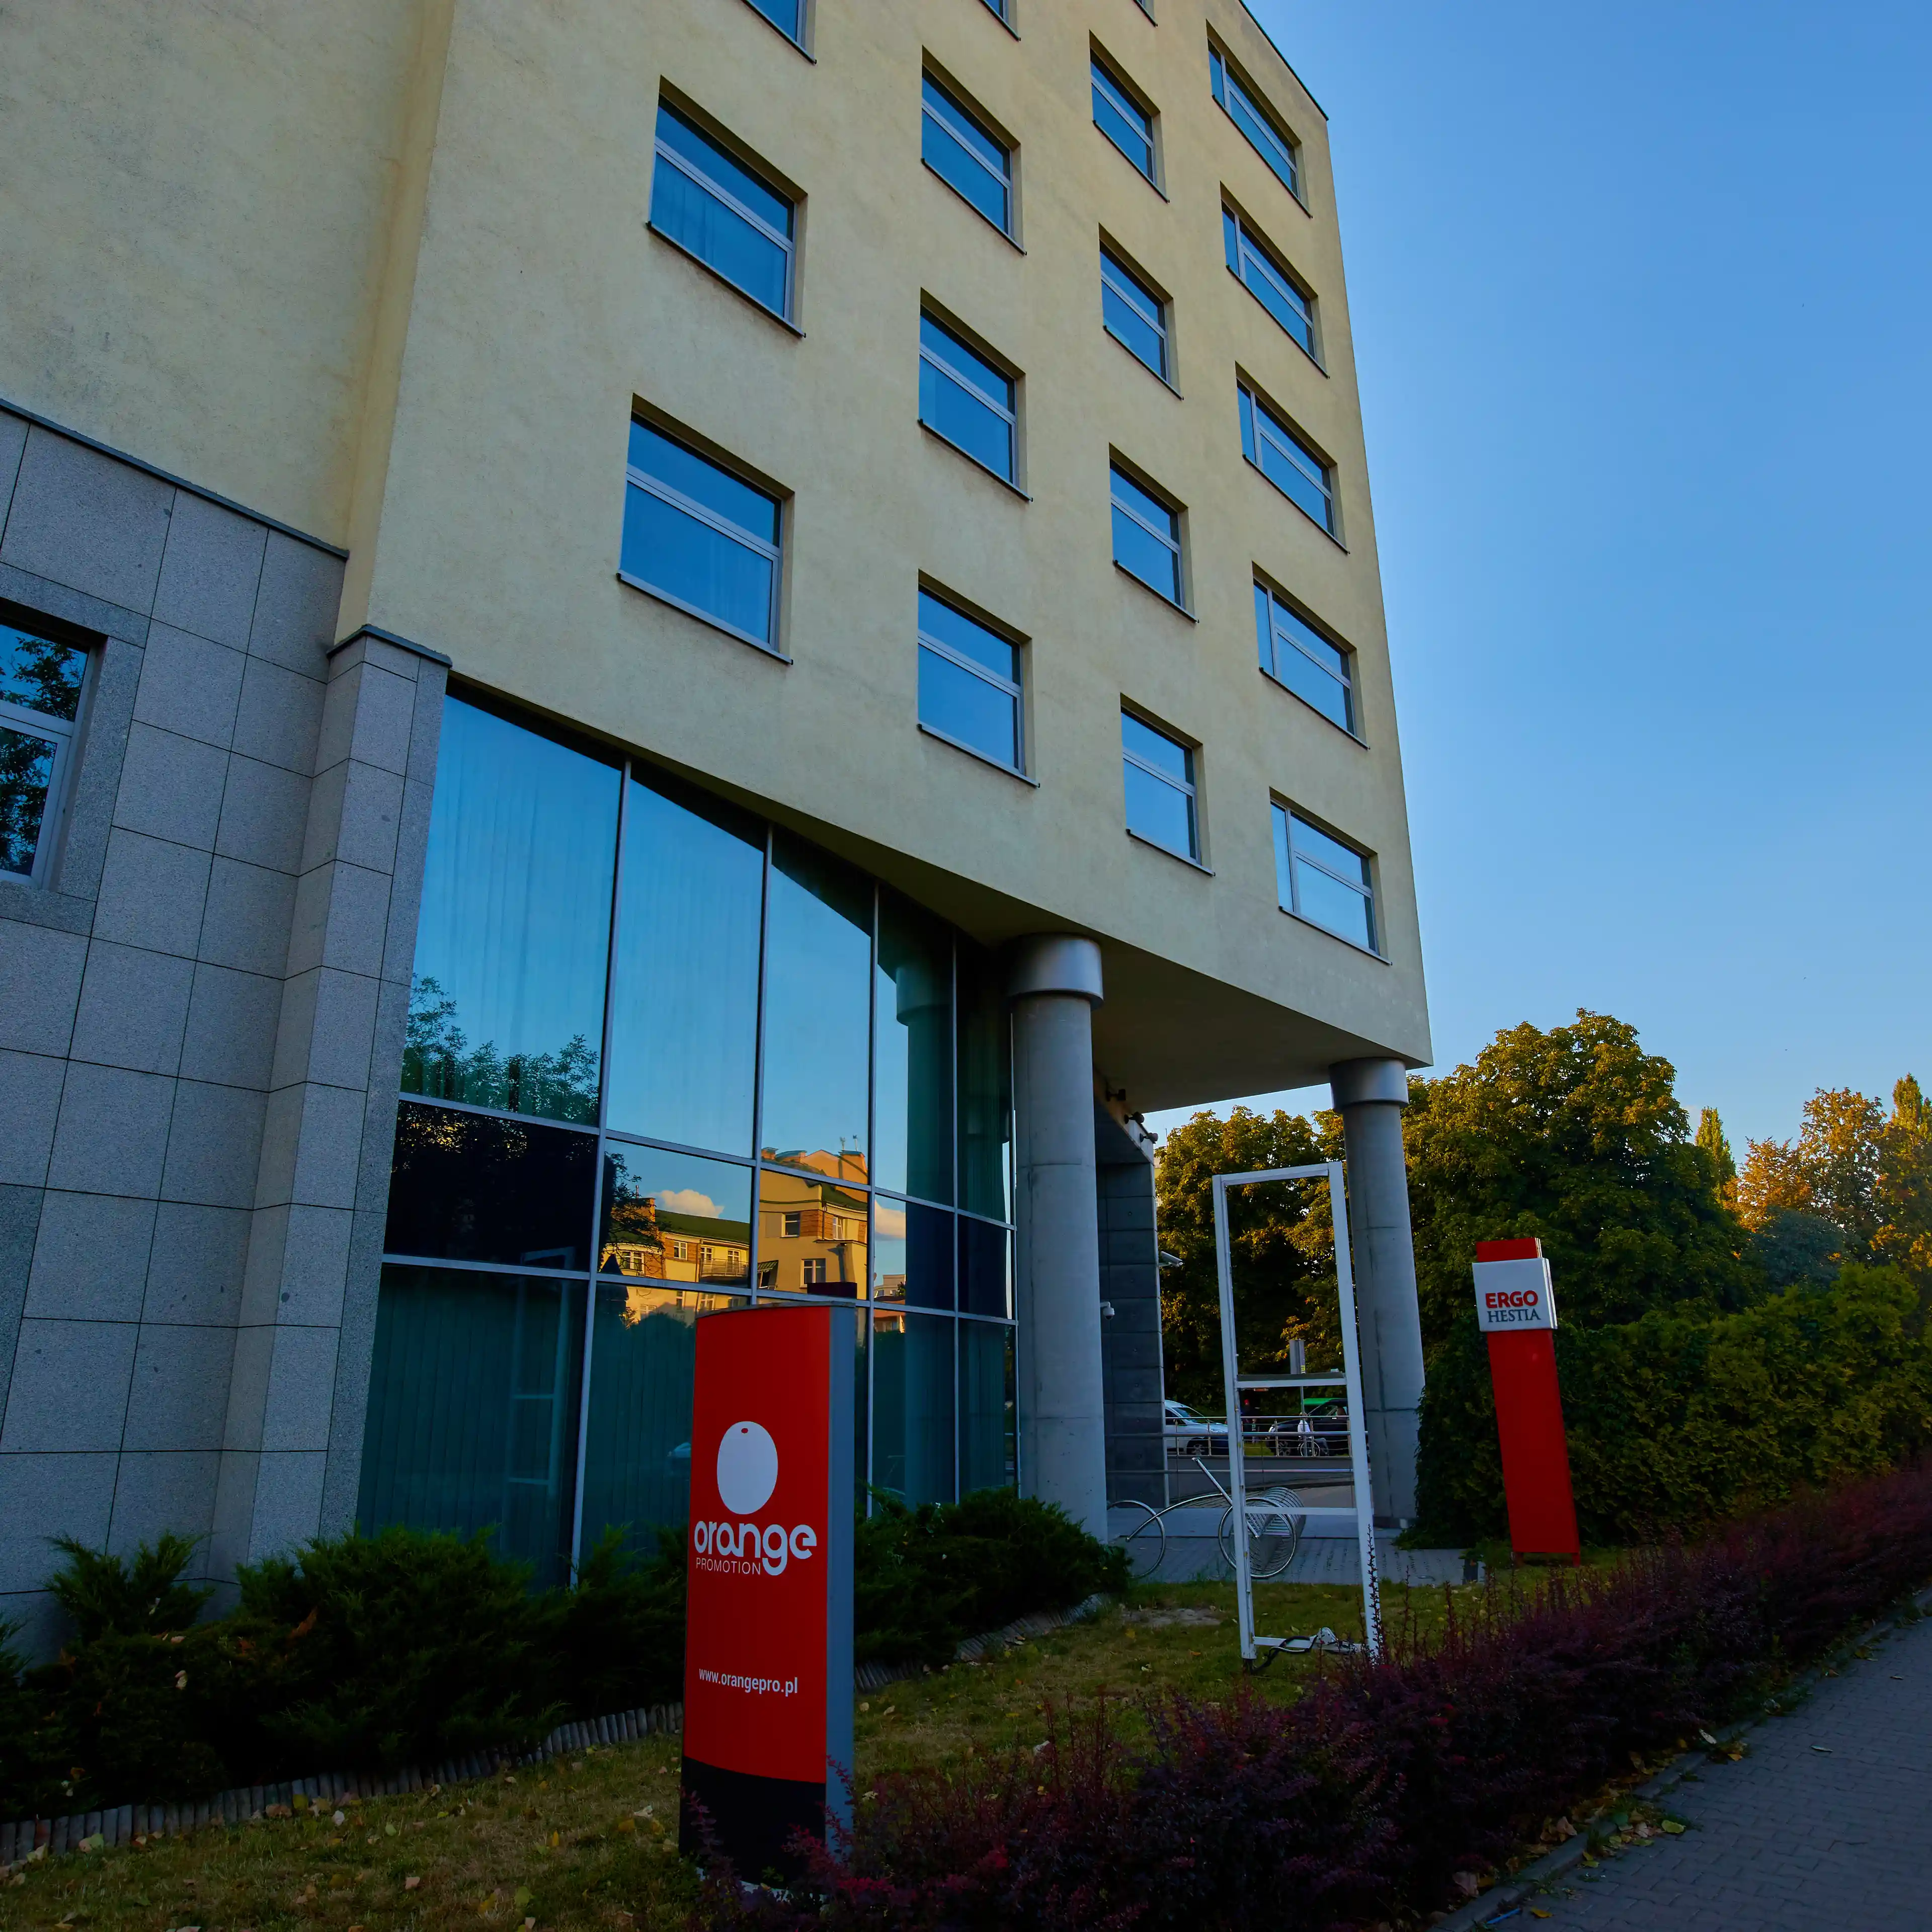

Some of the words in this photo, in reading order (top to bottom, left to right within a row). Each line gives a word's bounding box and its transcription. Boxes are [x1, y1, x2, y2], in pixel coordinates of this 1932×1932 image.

[1485, 1290, 1538, 1309] ERGO
[1487, 1308, 1541, 1322] HESTIA
[694, 1520, 817, 1576] orange
[696, 1557, 761, 1575] PROMOTION
[699, 1668, 798, 1697] www.orangepro.pl
